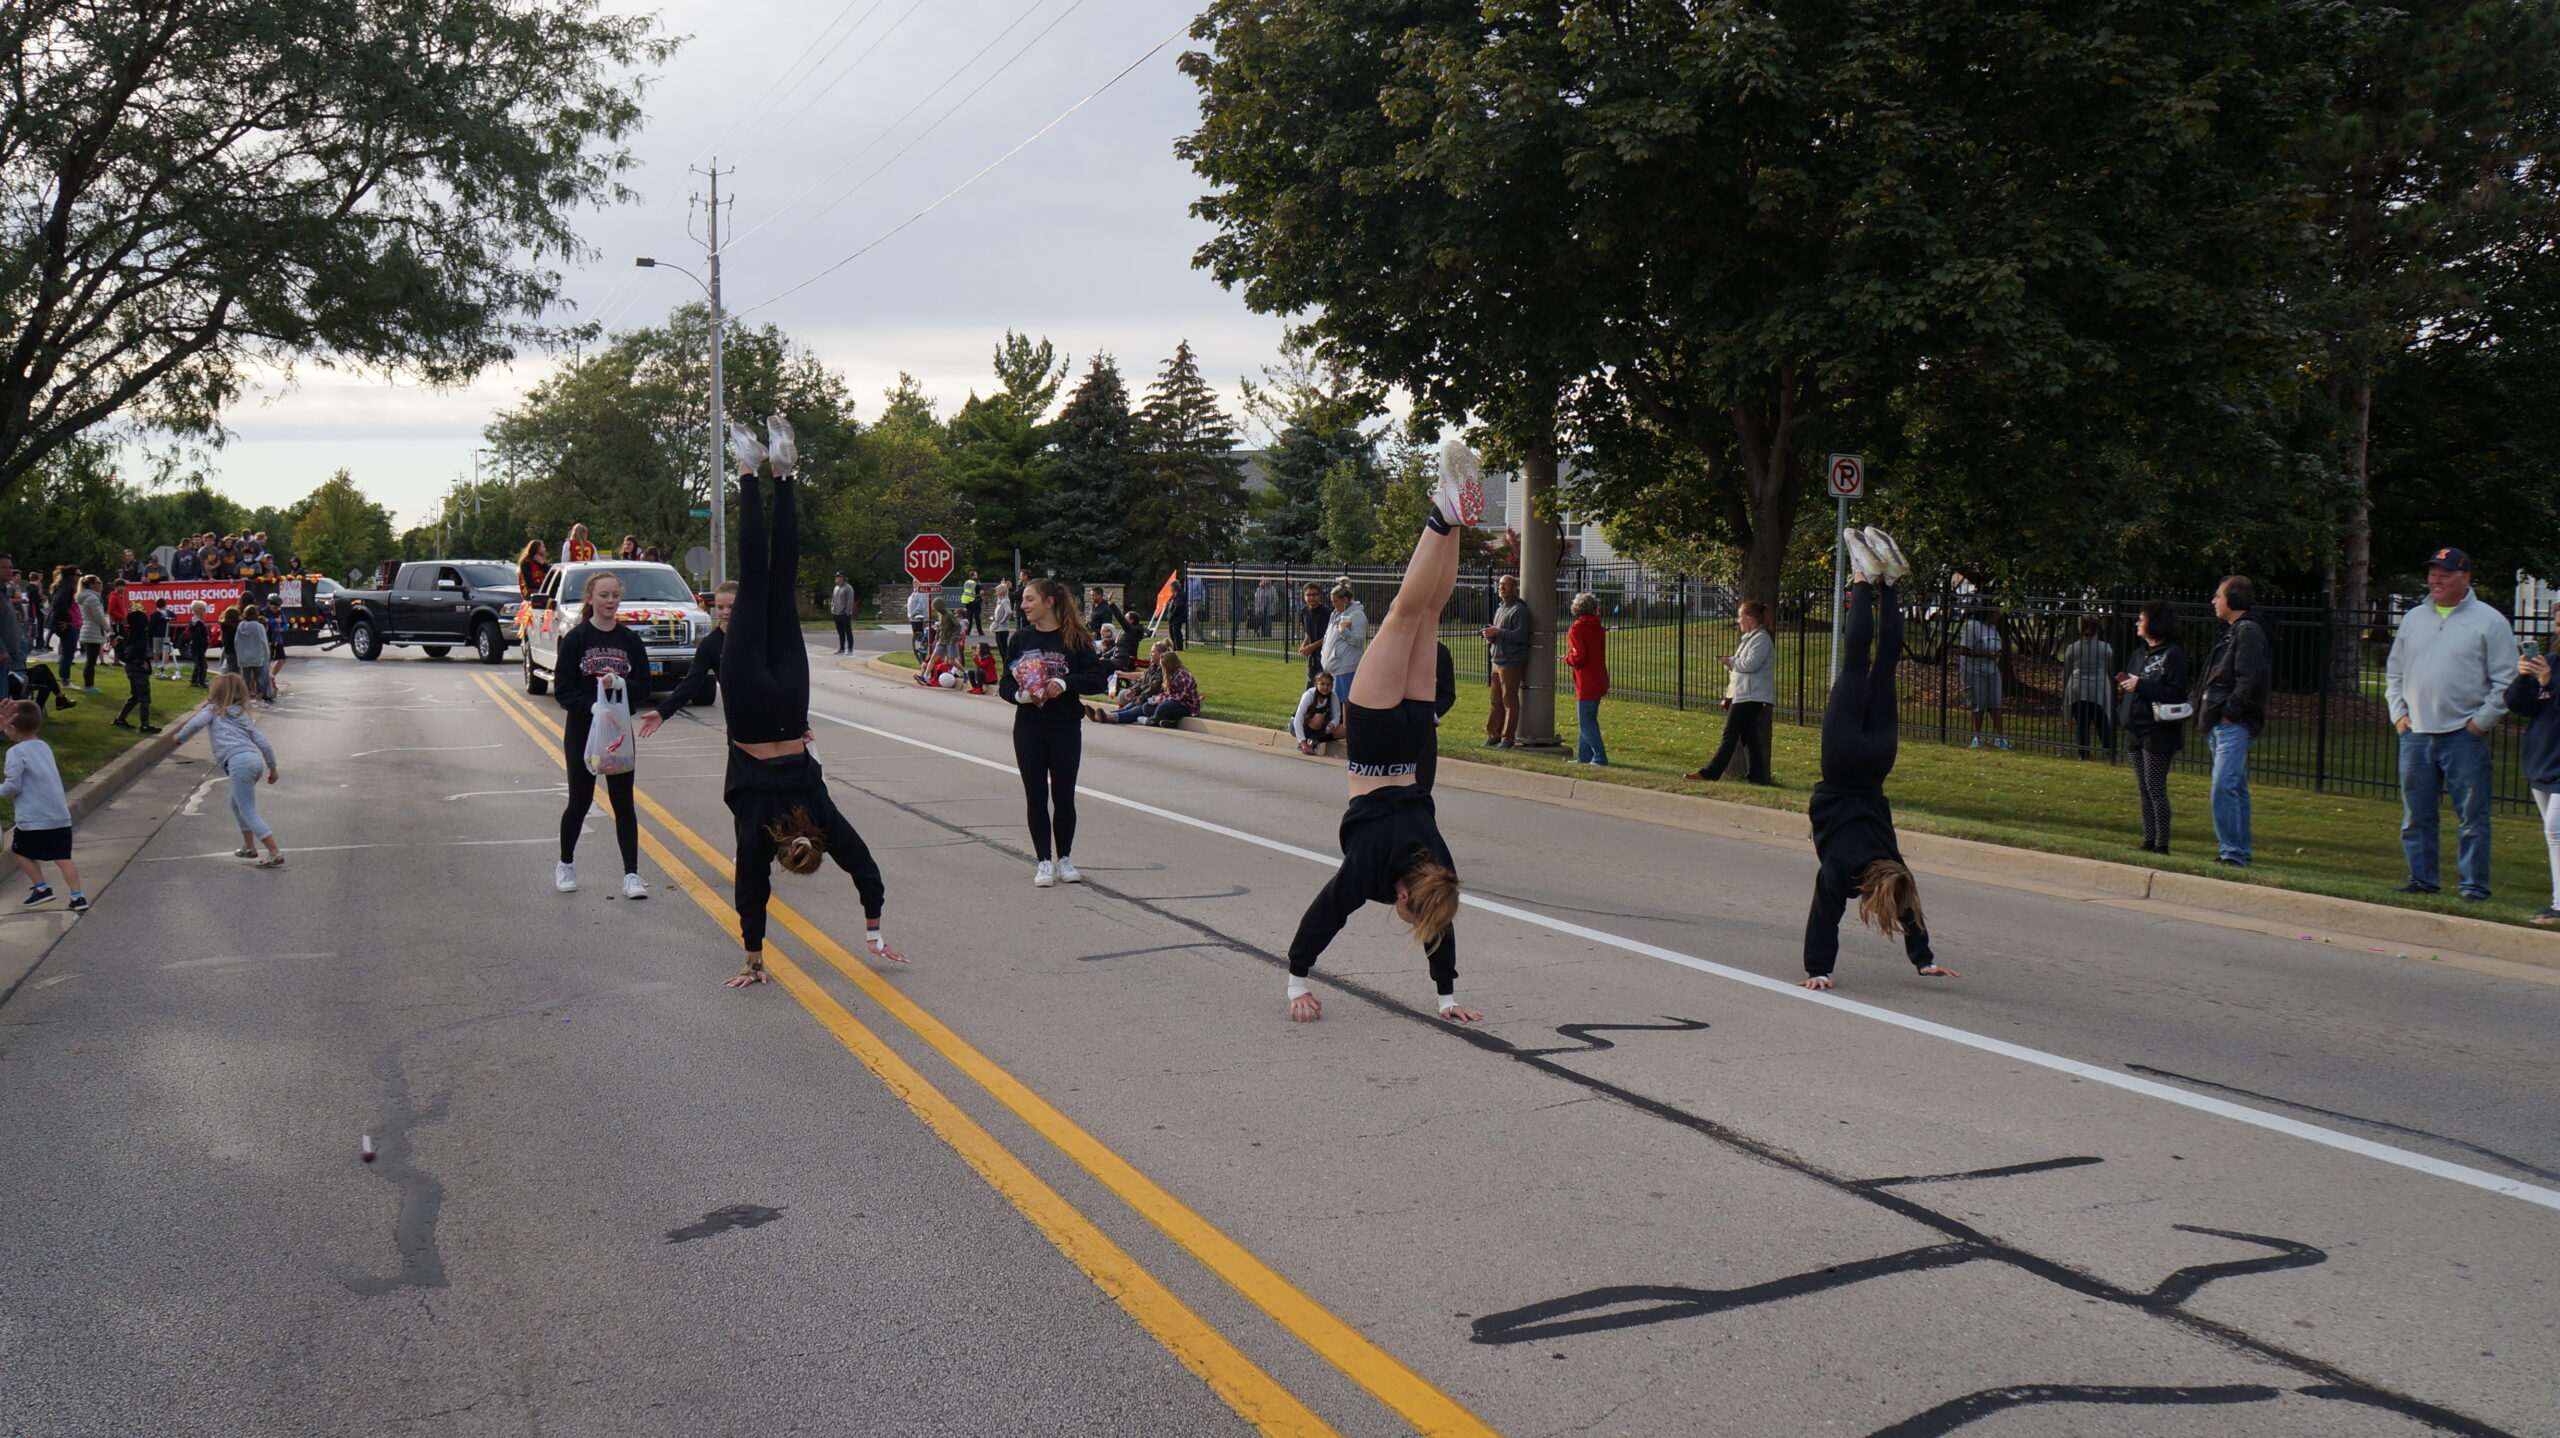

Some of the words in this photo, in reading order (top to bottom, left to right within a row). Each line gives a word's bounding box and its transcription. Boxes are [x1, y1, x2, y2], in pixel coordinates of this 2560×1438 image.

[909, 550, 950, 568] STOP
[128, 590, 171, 600] BATAVIA
[173, 589, 199, 600] HIGH
[200, 588, 241, 599] SCHOOL
[1350, 762, 1385, 776] NIKE
